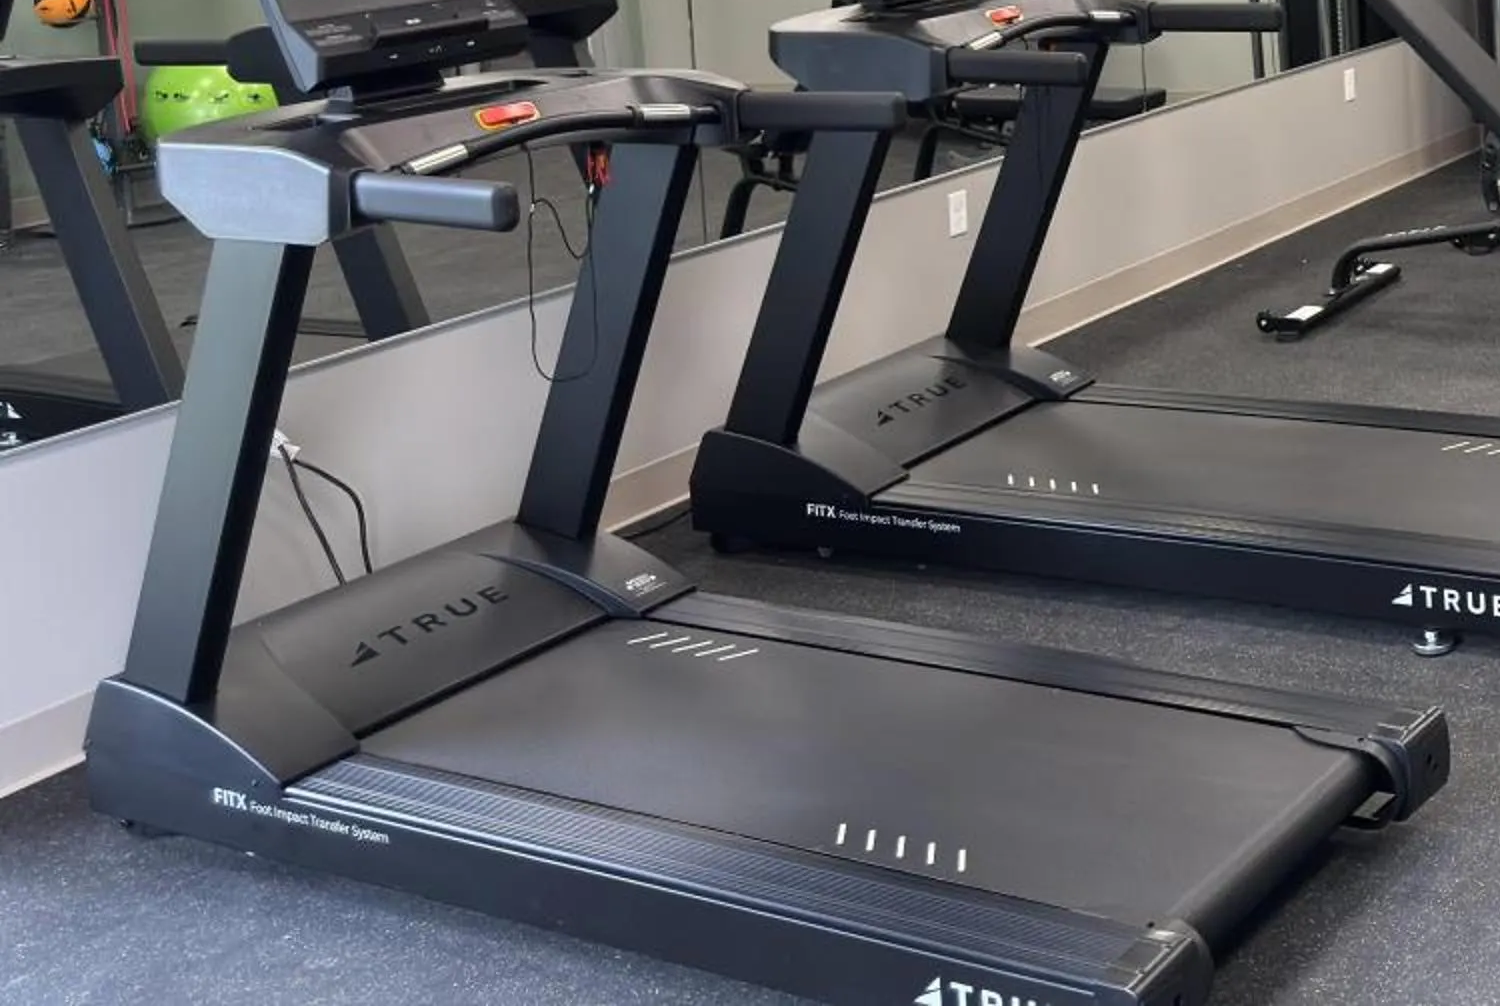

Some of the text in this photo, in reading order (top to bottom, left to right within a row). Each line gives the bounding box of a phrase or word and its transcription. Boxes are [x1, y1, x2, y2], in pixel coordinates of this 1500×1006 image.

[888, 376, 968, 413] TRUE
[806, 503, 961, 534] FITX Foot Impact Transfer System
[377, 586, 510, 645] TRUE
[211, 787, 390, 845] FITX Foot Impact Transfer System
